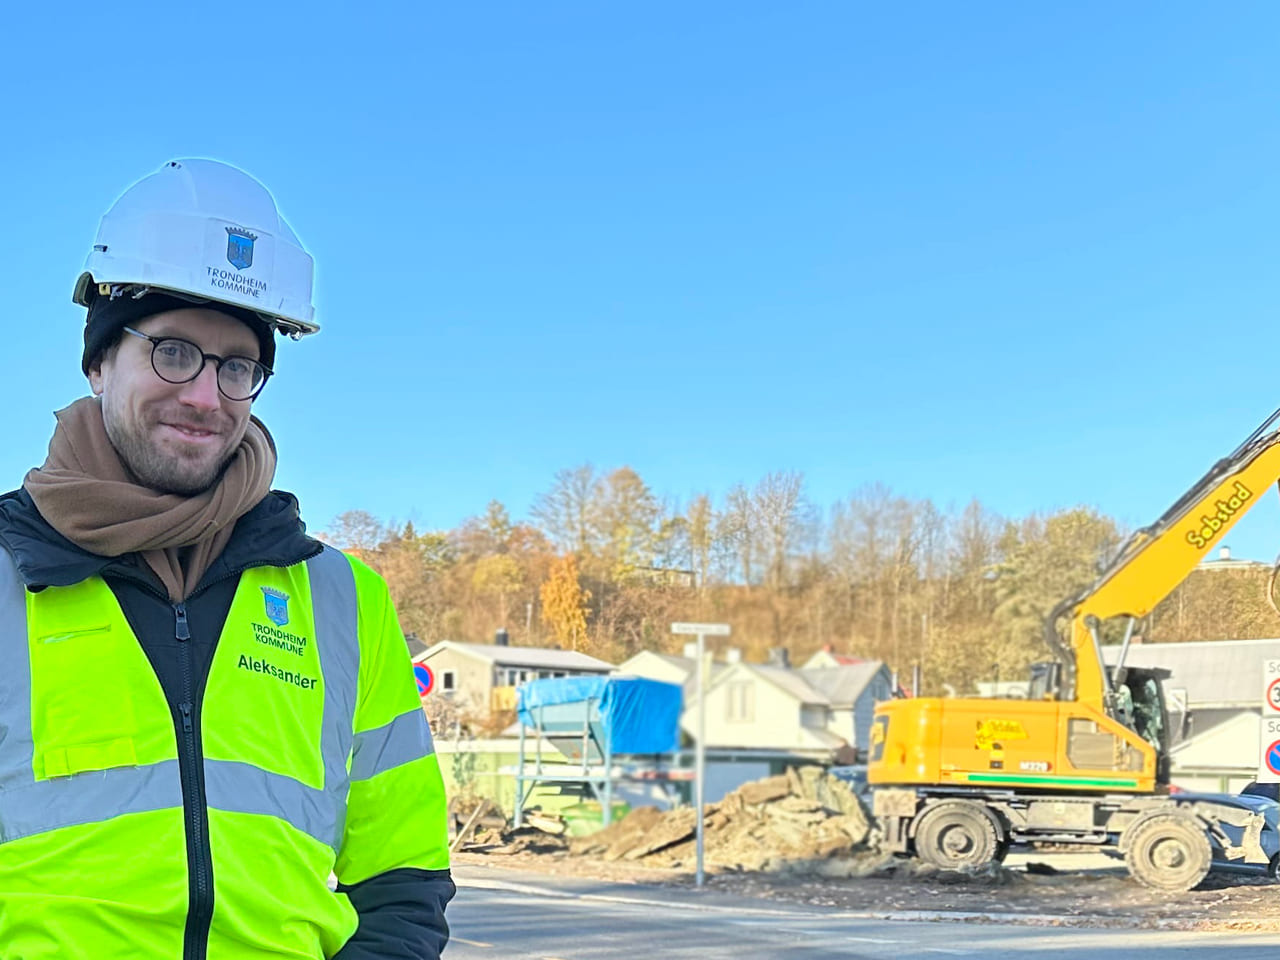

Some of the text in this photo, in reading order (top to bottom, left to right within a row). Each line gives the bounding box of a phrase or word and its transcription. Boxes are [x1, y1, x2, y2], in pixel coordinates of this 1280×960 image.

[207, 267, 267, 291] TRONDHEIM
[211, 278, 260, 298] KOMMUNE
[251, 622, 307, 646] TRONDHEIM
[255, 634, 304, 656] KOMMUNE
[238, 655, 317, 690] Aleksander
